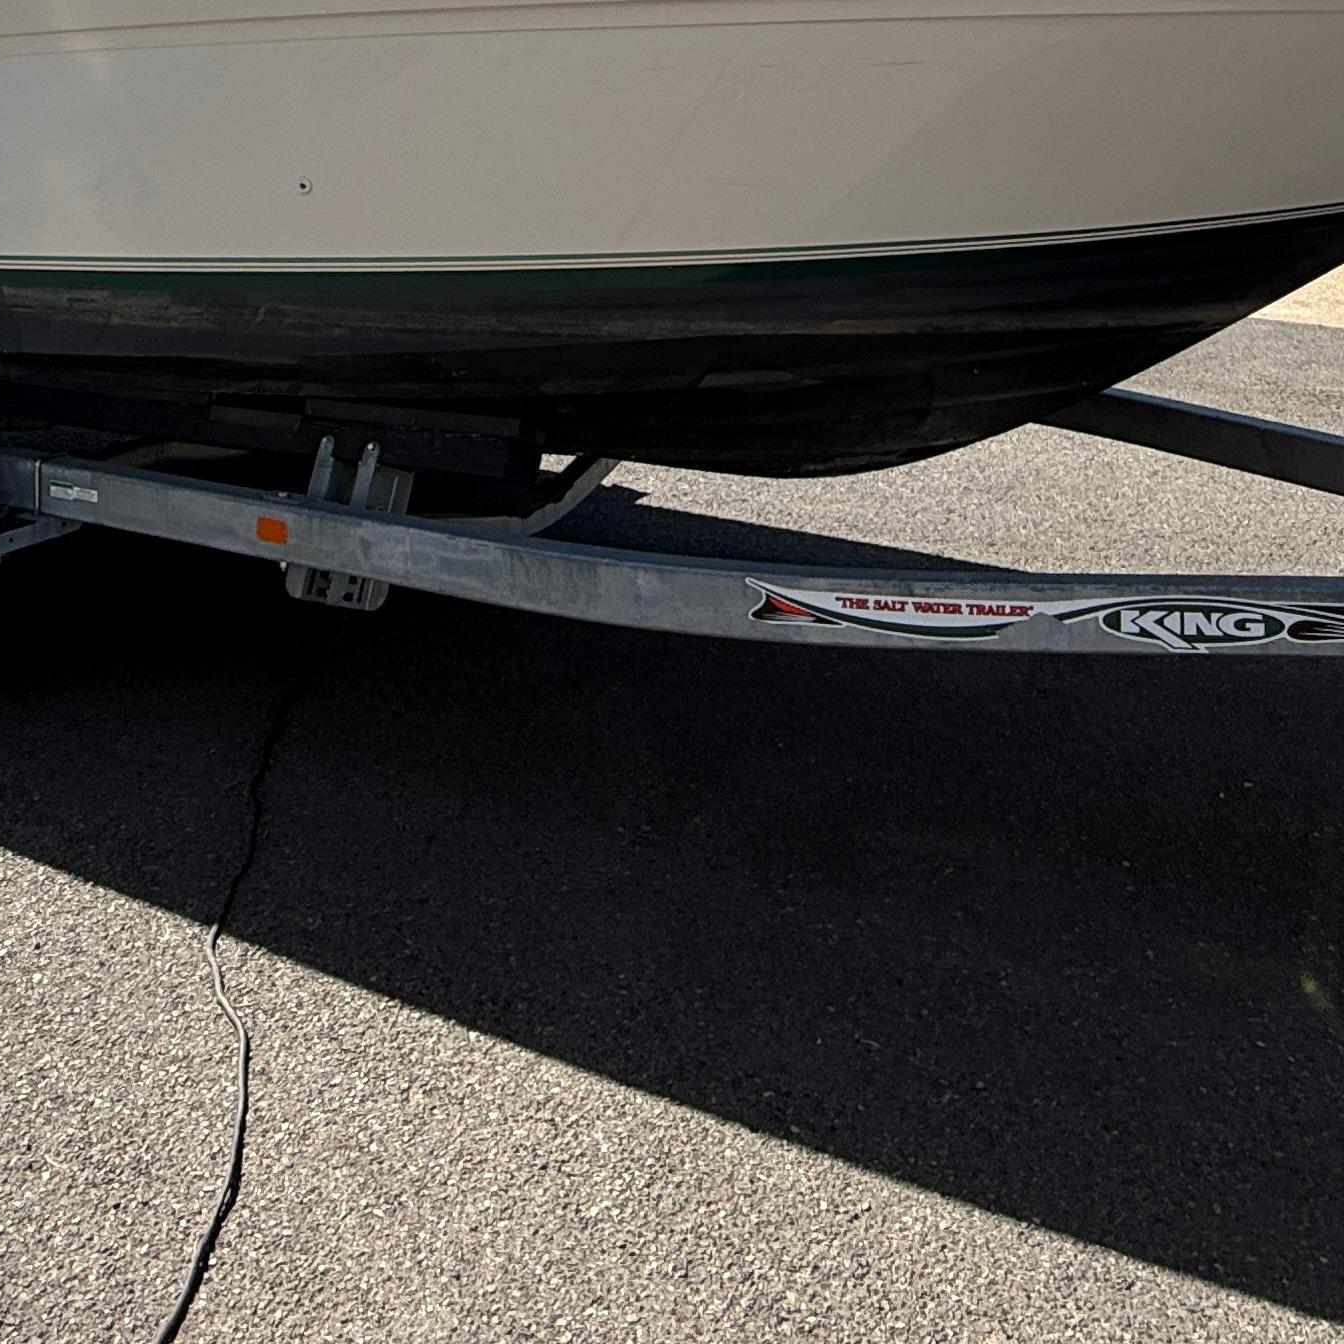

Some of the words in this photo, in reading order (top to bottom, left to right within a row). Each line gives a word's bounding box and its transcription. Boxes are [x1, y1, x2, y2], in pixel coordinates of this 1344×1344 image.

[873, 599, 909, 613] SALT
[912, 601, 964, 615] WATER
[1120, 609, 1266, 650] KING
